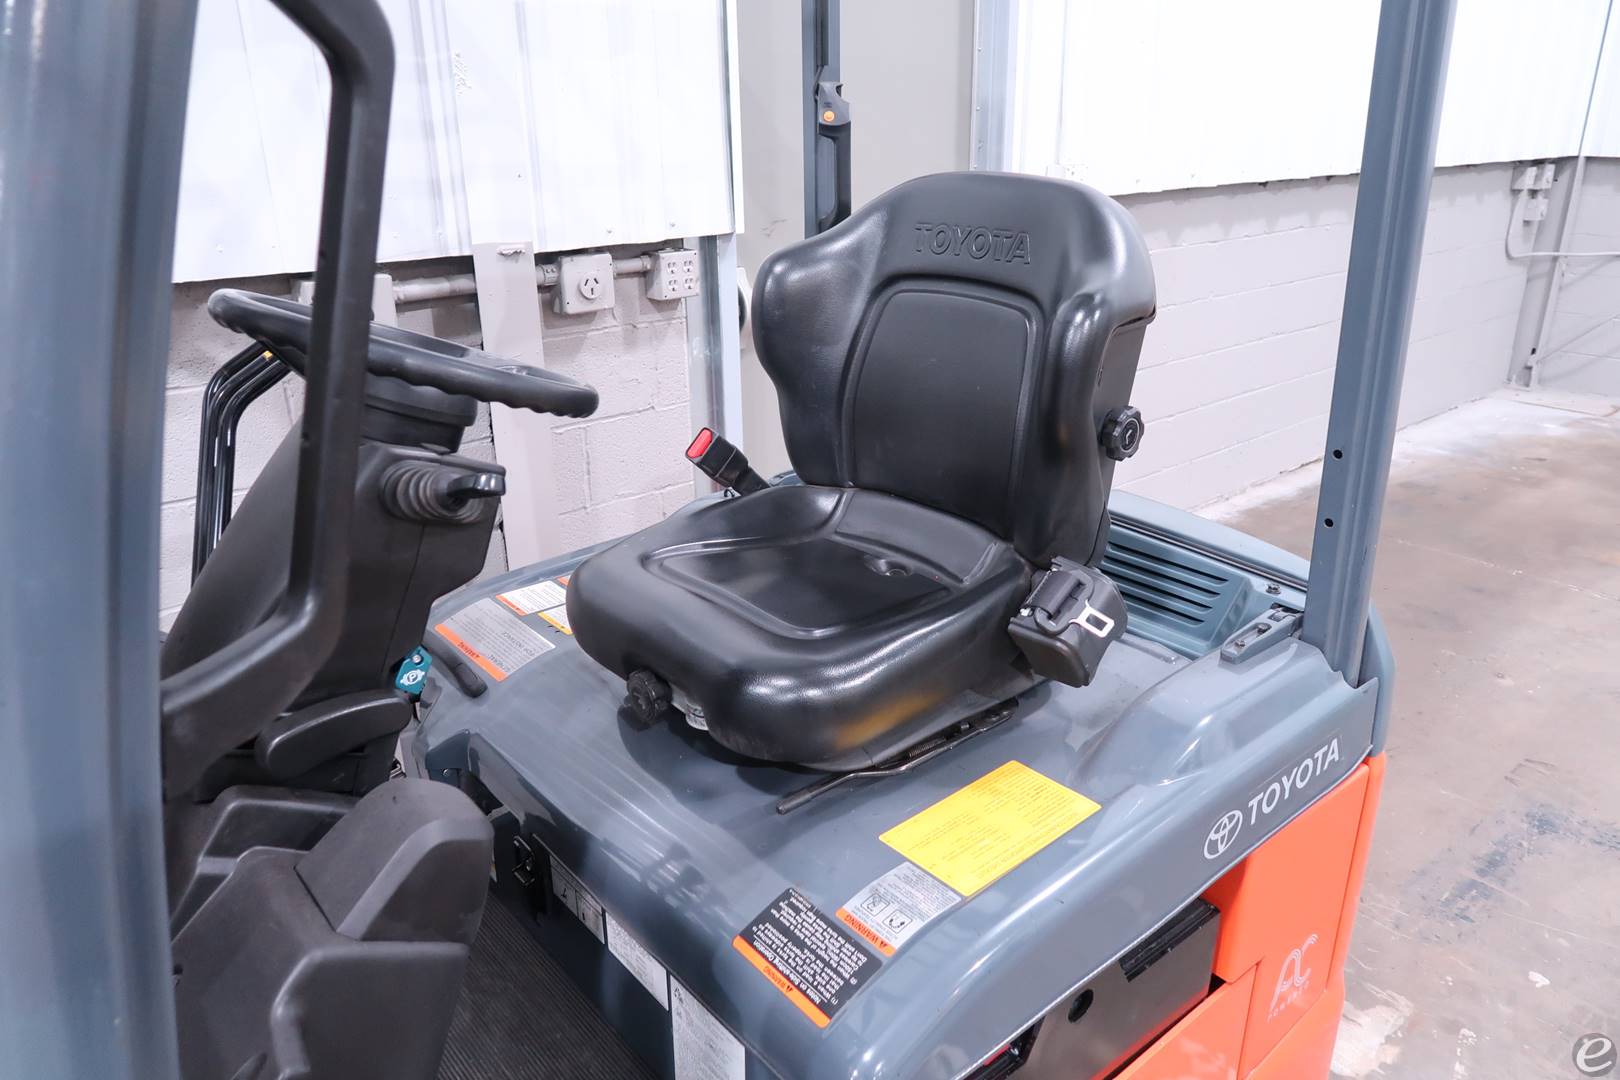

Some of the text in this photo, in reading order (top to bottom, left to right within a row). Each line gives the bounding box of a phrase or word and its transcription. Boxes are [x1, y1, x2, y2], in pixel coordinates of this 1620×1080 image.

[914, 222, 1031, 265] TOYOTA
[1247, 737, 1340, 826] TOYOTA
[768, 907, 780, 918] than
[793, 914, 803, 923] the
[750, 924, 758, 932] to
[842, 913, 880, 943] WARNING
[755, 929, 773, 946] shifted
[802, 936, 813, 946] the
[751, 938, 776, 962] Operation
[770, 942, 778, 950] is
[781, 945, 796, 959] forks
[775, 947, 789, 960] forks
[786, 957, 797, 967] the
[793, 956, 804, 966] the
[803, 957, 811, 965] is
[814, 958, 825, 968] the
[827, 958, 838, 968] the
[794, 964, 804, 973] on
[801, 962, 815, 976] shift
[808, 961, 822, 974] load
[835, 964, 851, 979] When
[801, 970, 814, 983] load
[819, 971, 830, 981] the
[797, 981, 808, 991] on
[824, 982, 836, 995] one
[828, 978, 840, 990] that
[804, 987, 822, 1005] Notes
[815, 983, 832, 999] When
